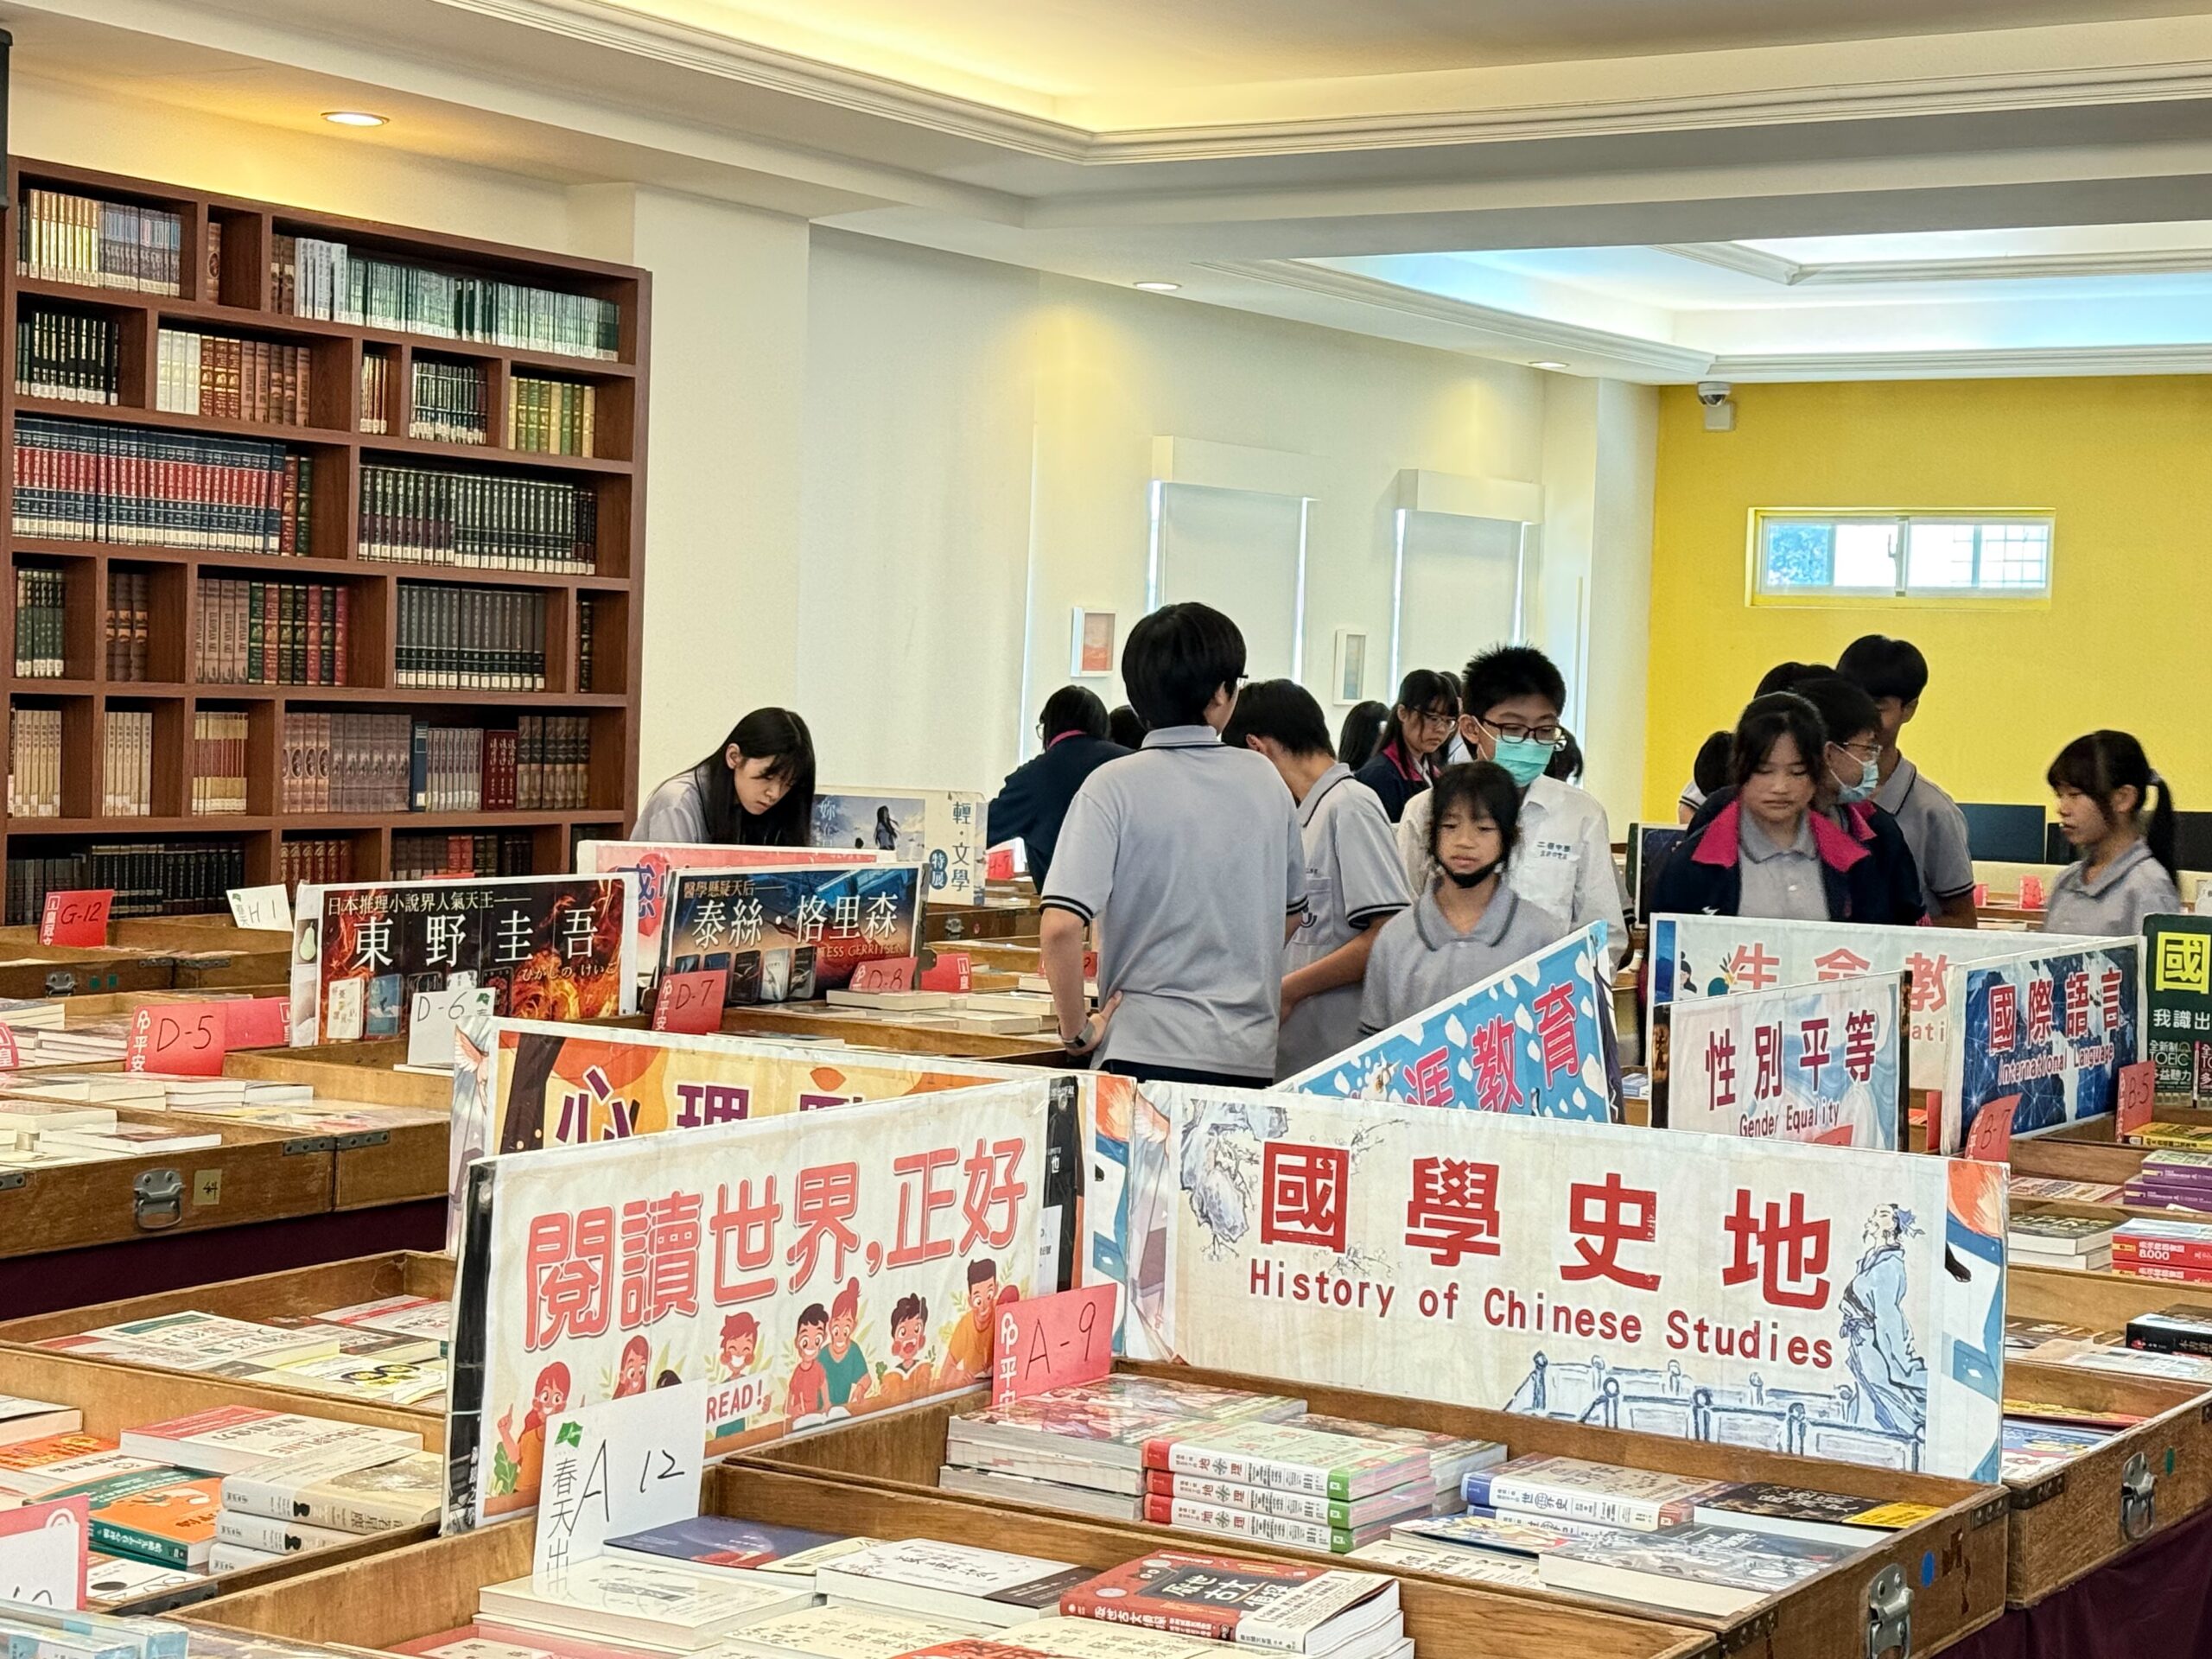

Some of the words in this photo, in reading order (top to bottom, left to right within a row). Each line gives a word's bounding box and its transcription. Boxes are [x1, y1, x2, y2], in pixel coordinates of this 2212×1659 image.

[931, 851, 945, 887] 特展
[60, 902, 102, 925] G-12
[691, 891, 898, 950] 泰絲·格里森
[348, 906, 599, 972] 東野圭吾
[821, 945, 845, 959] TESS
[848, 942, 905, 957] GERRITSEN
[522, 965, 573, 982] ひがしの
[2155, 931, 2212, 994] 國
[416, 991, 467, 1023] D-6
[675, 979, 715, 1011] D-7
[1988, 967, 2124, 1057] 國際語言
[156, 1014, 214, 1052] D-5
[655, 1001, 669, 1031] 平安
[130, 1034, 148, 1072] 平安
[1705, 1009, 1877, 1112] 性別平等
[1997, 1049, 2067, 1086] International
[2074, 1042, 2114, 1071] Language
[2149, 1051, 2190, 1067] TOEIC
[1738, 1111, 1779, 1138] Gender
[1786, 1097, 1840, 1135] Equality
[1259, 1141, 1832, 1311] 國學史地
[1249, 1258, 1395, 1319] History
[1419, 1282, 1459, 1319] of
[1484, 1287, 1643, 1344] Chinese
[1665, 1309, 1834, 1370] Studies
[1025, 1301, 1097, 1381] A-9
[706, 1382, 763, 1424] READ!
[569, 1439, 610, 1537] A
[639, 1449, 685, 1494] 12
